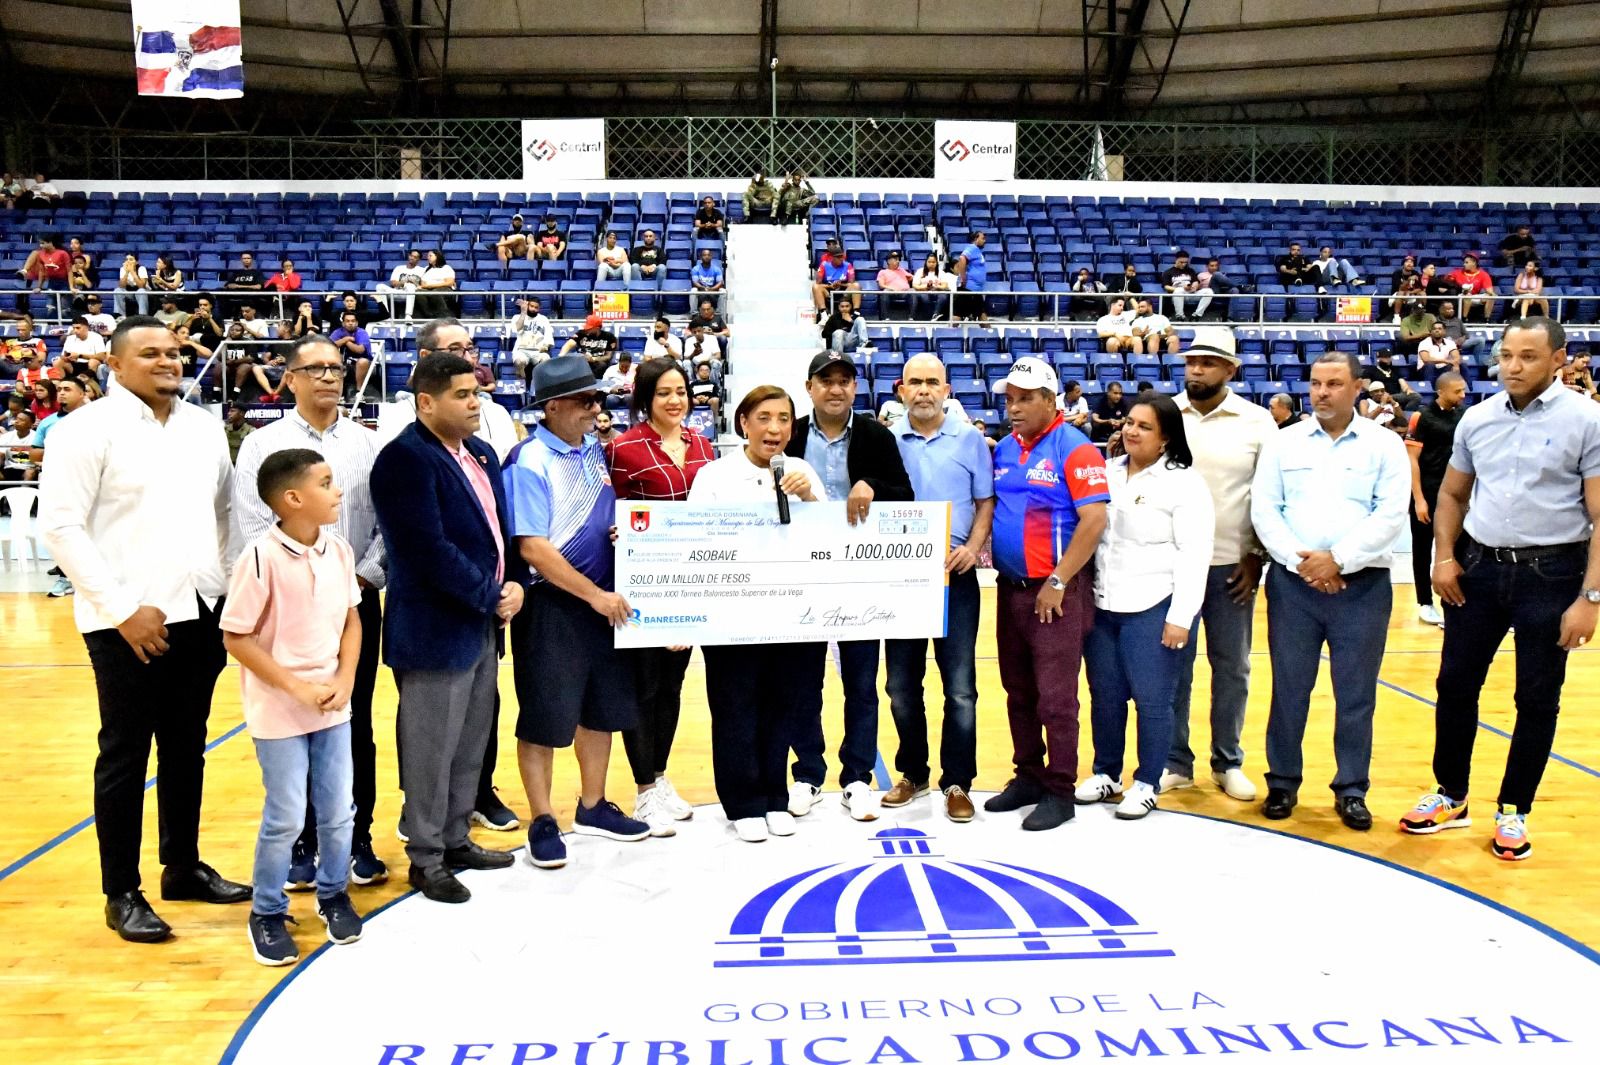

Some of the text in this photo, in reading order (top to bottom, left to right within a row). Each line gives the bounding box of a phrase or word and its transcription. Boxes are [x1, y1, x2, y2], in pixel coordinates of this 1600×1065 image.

[560, 141, 601, 152] Central
[972, 143, 1012, 154] Central
[1026, 468, 1060, 484] PRENSA
[892, 509, 923, 518] 156978
[688, 550, 738, 562] ASOBAVE
[811, 543, 933, 560] RD$ 1,000,000.00
[629, 574, 654, 585] SOLO
[656, 574, 670, 584] UN
[706, 574, 719, 584] DE
[721, 573, 751, 583] PESOS
[629, 591, 663, 599] Patrocinio
[680, 590, 702, 598] Torneo
[703, 589, 738, 598] Baloncesto
[740, 588, 767, 598] Superior
[769, 588, 777, 597] de
[778, 588, 787, 597] La
[788, 588, 804, 598] Vega
[644, 615, 708, 624] BANRESERVAS
[703, 991, 1226, 1022] GOBIERNO DE LA
[376, 1014, 1574, 1065] REPÚBLICA DOMINICANA
